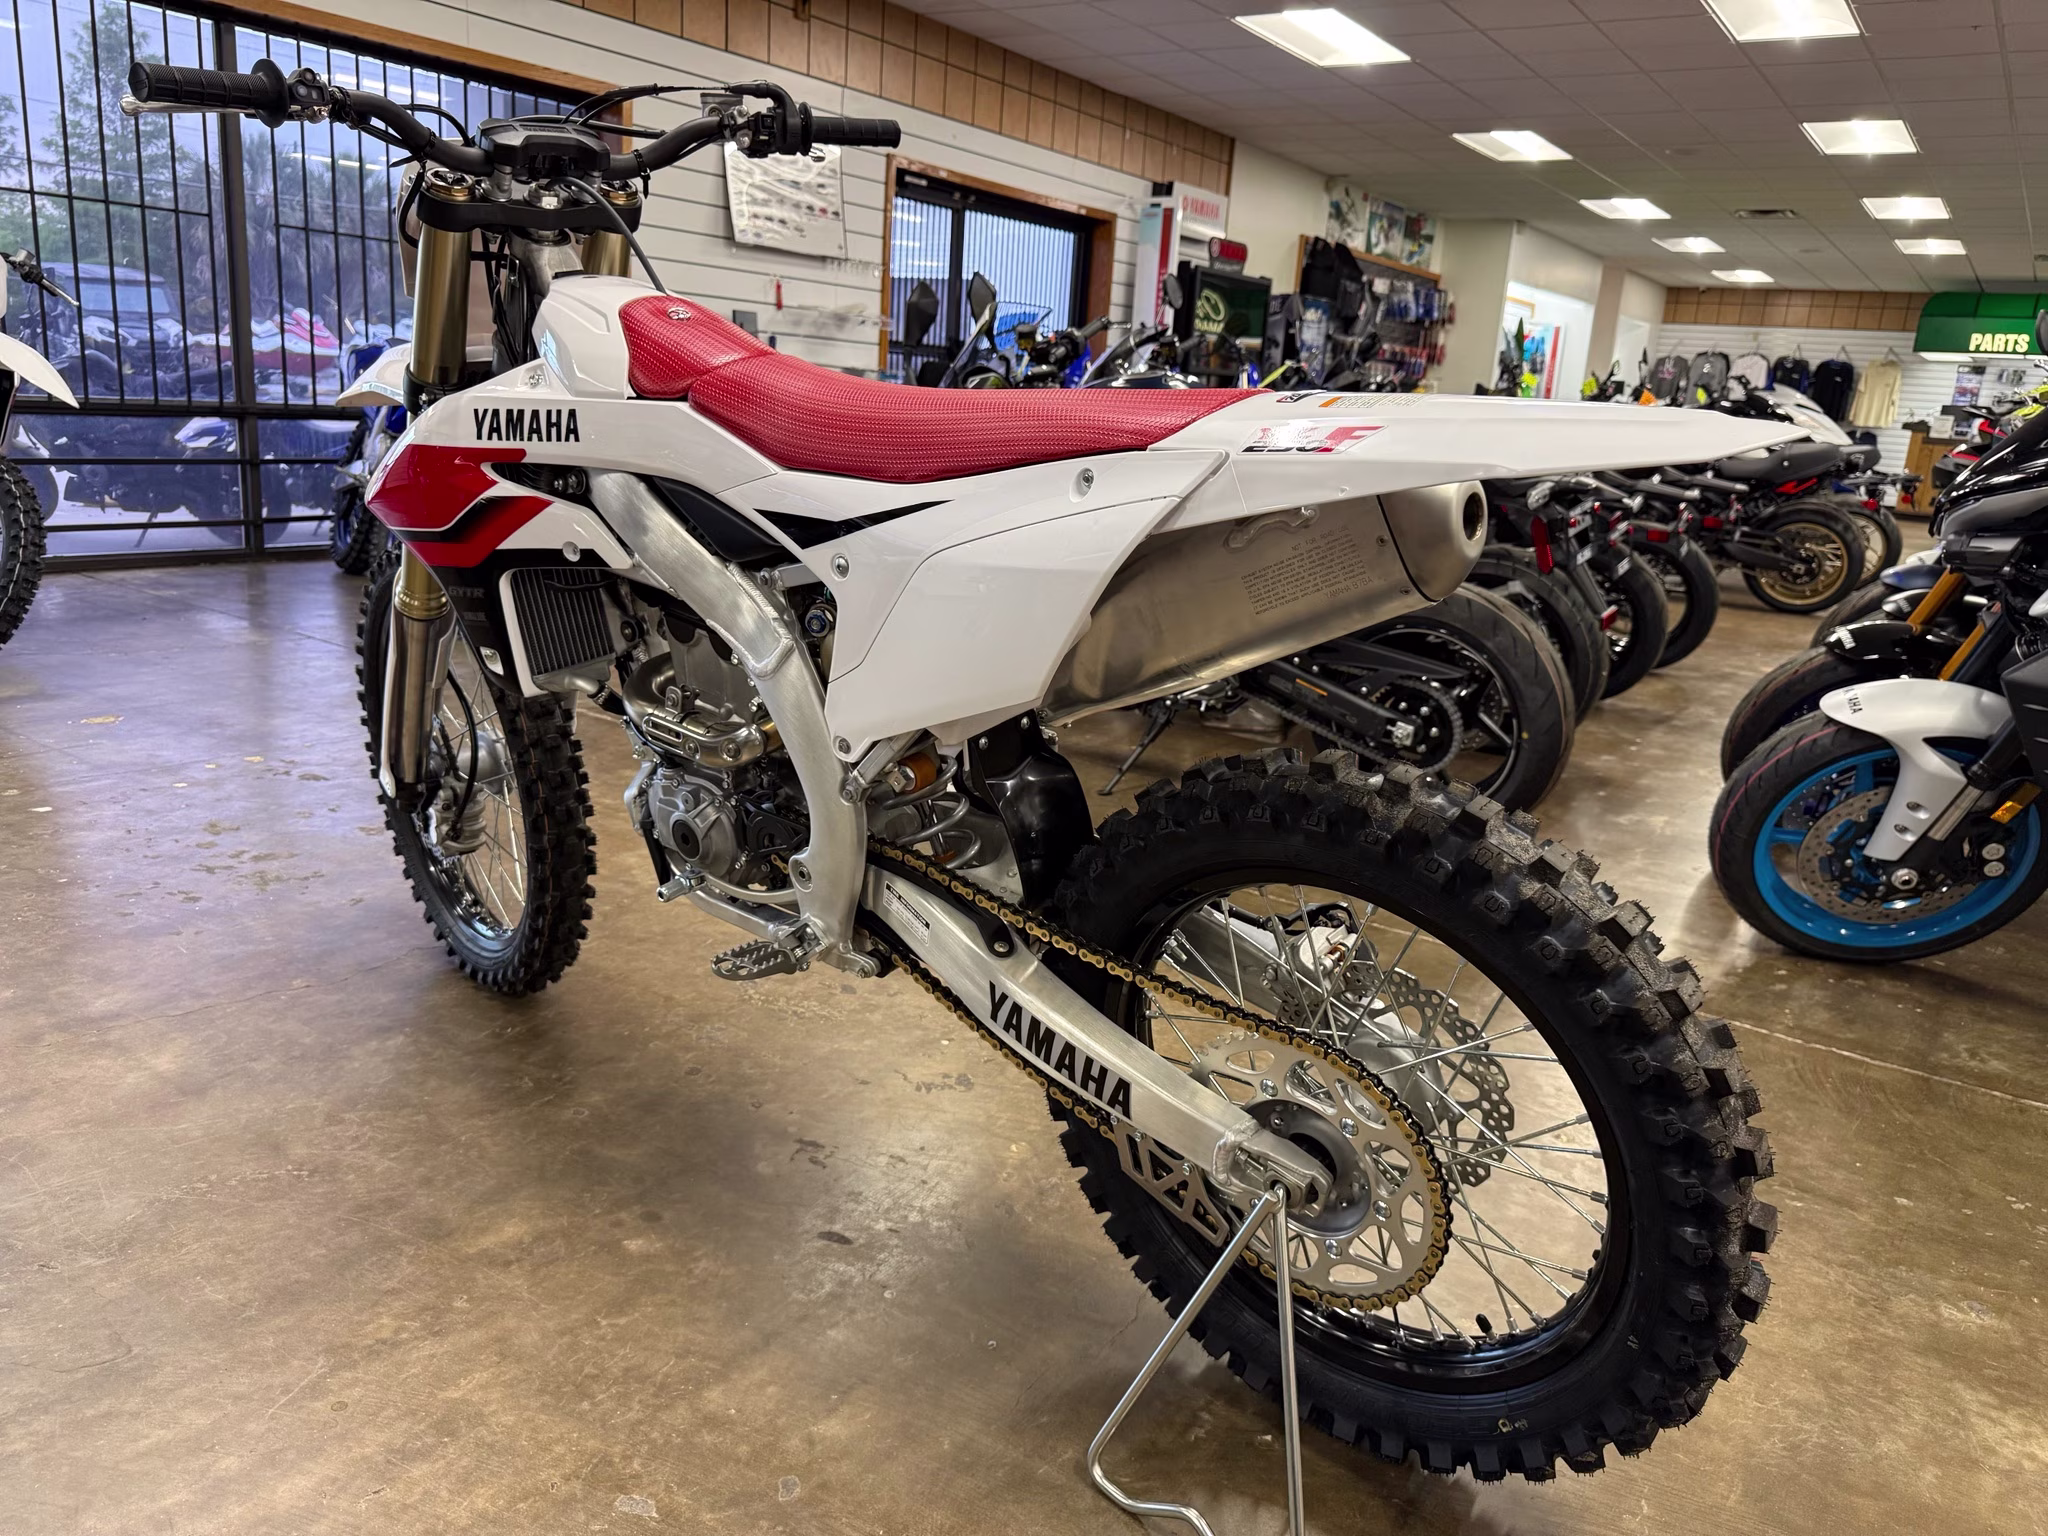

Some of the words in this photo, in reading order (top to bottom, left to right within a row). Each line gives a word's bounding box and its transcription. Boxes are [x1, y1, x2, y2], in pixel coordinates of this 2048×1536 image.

[1968, 333, 2030, 353] PARTS
[473, 408, 580, 442] YAMAHA
[989, 980, 1133, 1121] YAMAHA
